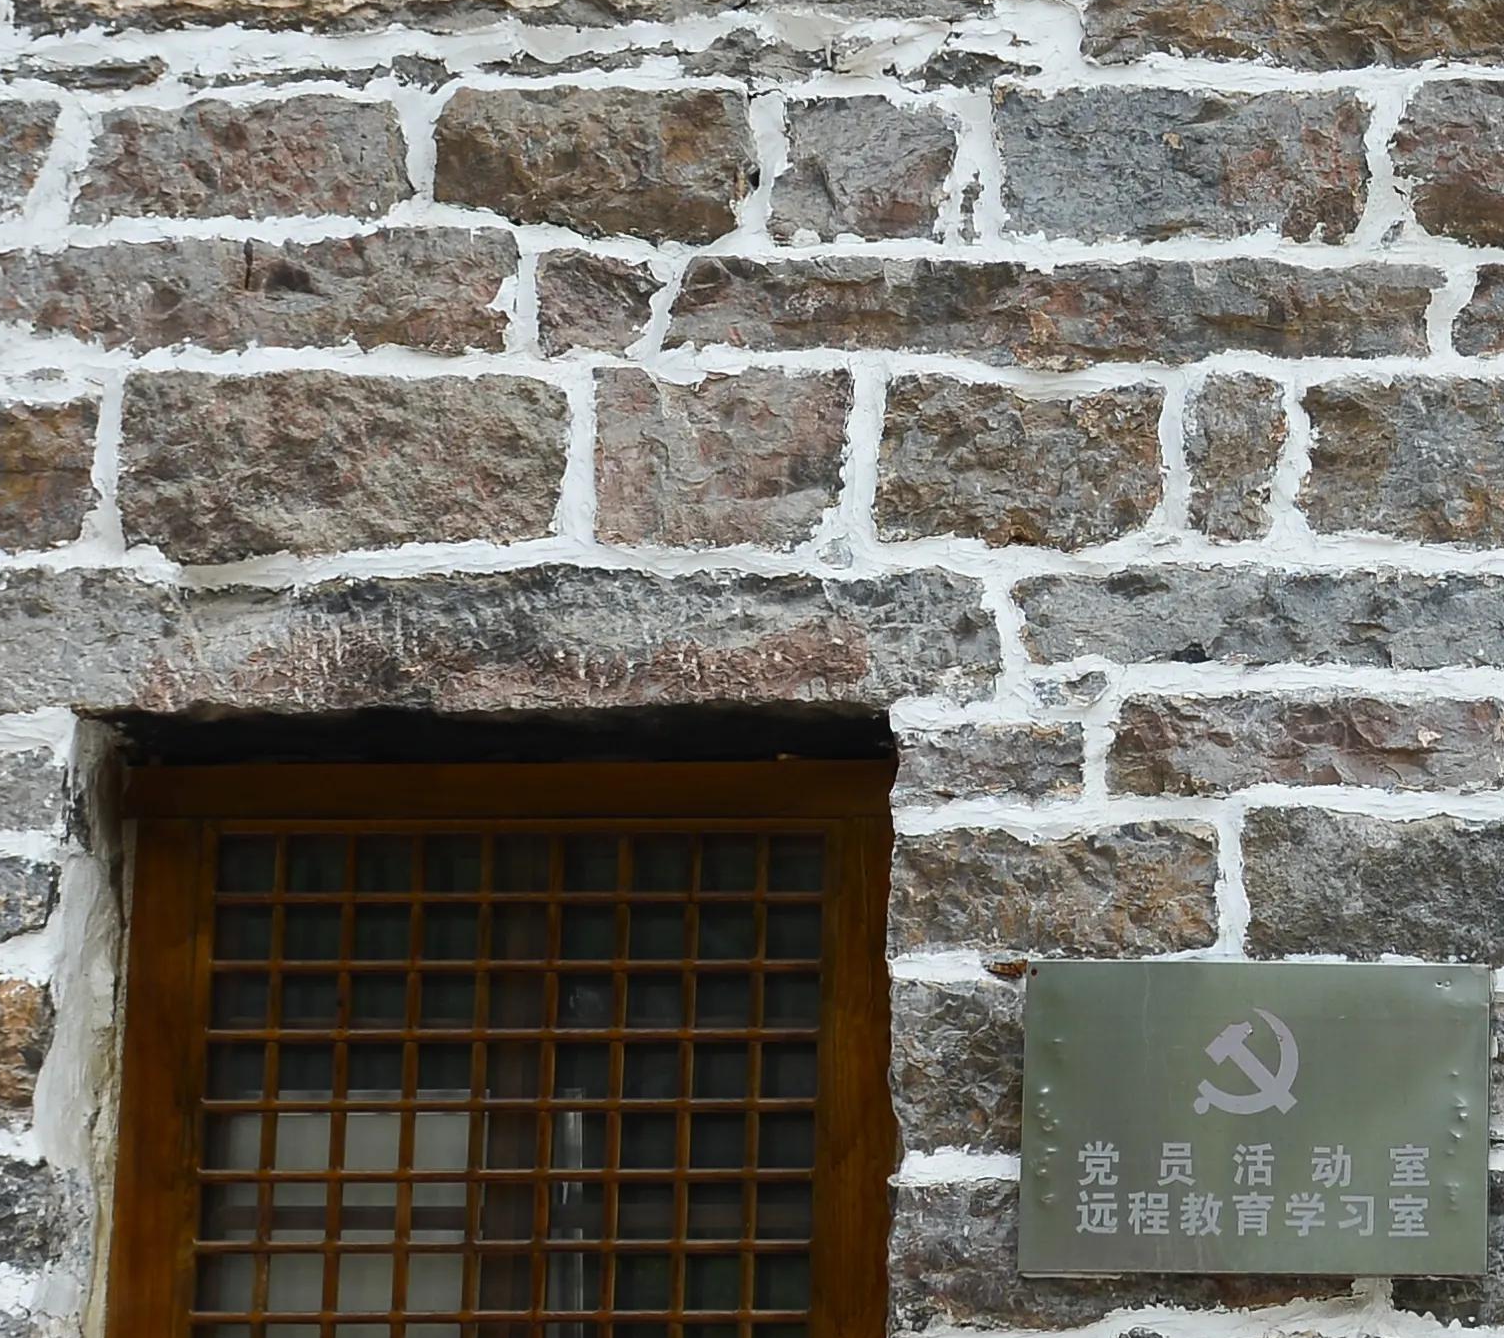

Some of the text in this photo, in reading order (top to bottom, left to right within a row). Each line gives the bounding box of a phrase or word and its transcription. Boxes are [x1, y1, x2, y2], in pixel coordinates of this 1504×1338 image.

[1077, 1141, 1431, 1188] 党员活动室
[1076, 1191, 1430, 1238] 远程教育学习室
